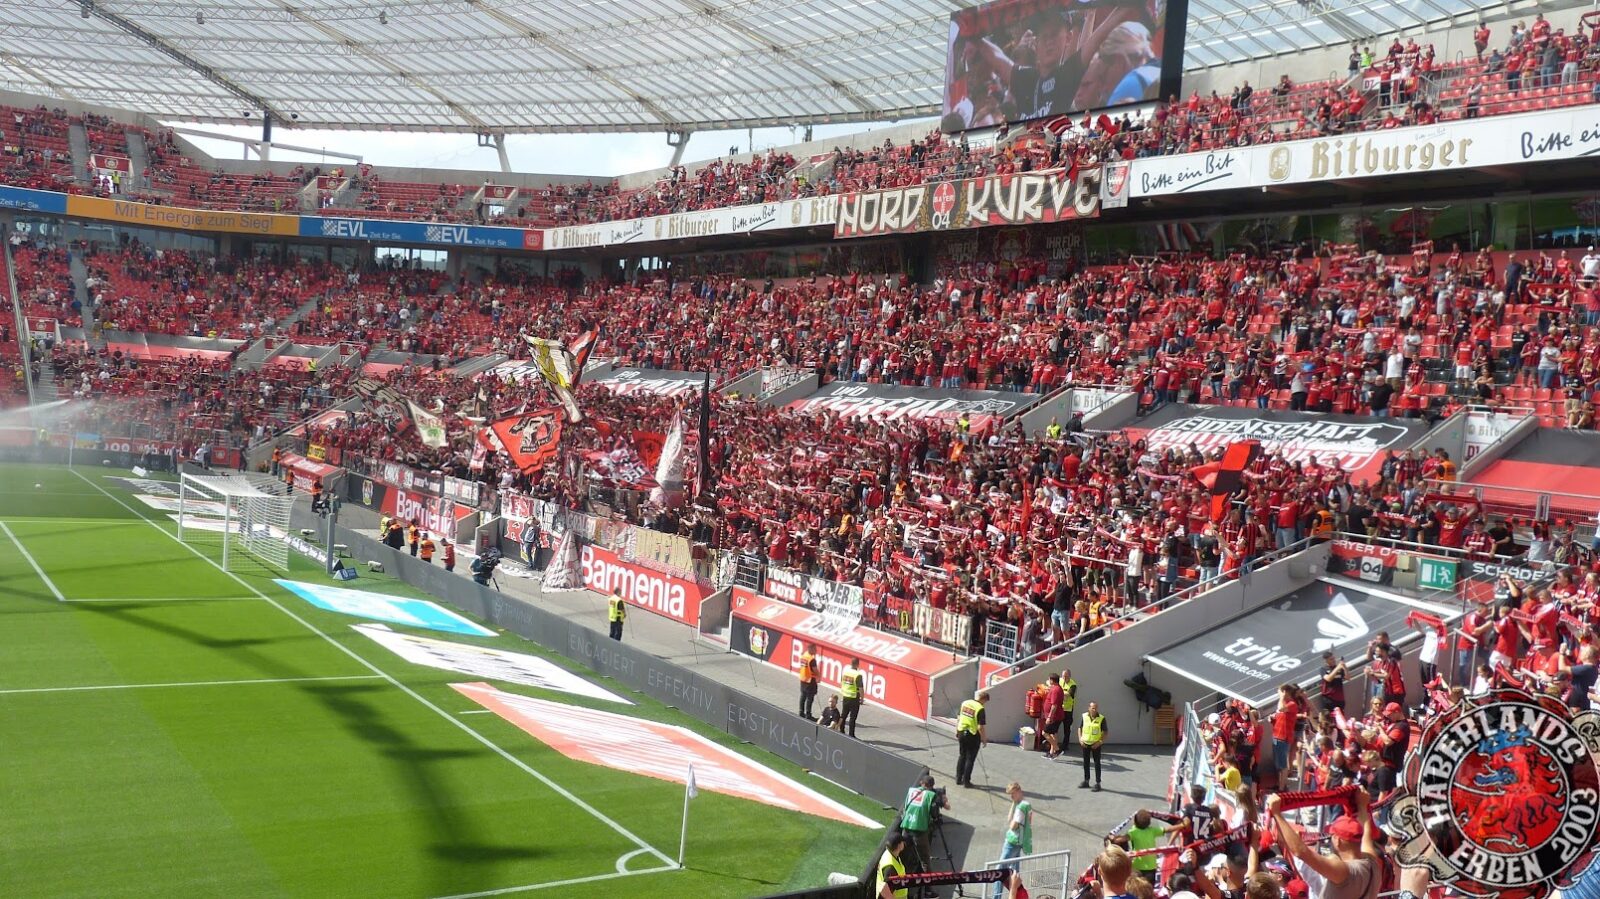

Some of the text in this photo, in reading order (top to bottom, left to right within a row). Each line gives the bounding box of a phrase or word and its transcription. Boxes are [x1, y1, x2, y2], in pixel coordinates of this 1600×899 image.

[1521, 122, 1600, 158] Bitte ei
[1309, 136, 1473, 179] Bitburger
[1142, 172, 1173, 193] Bitte
[1177, 167, 1202, 181] ein
[1205, 153, 1235, 174] Bit
[837, 186, 926, 234] NORD
[967, 168, 1102, 222] KURVE
[115, 202, 273, 232] Mit Energie zum Sieg!
[633, 221, 644, 234] Bit
[668, 217, 719, 237] Bitburger
[733, 205, 777, 231] Bitte ein Bit
[932, 212, 950, 229] 04
[337, 221, 368, 238] EVL
[441, 227, 473, 244] EVL
[563, 230, 601, 247] Bitburger
[1046, 236, 1061, 249] IHR
[1052, 247, 1071, 260] UNS
[1166, 418, 1384, 440] LEIDENSCHAFT
[767, 566, 802, 588] YOUNG
[1361, 562, 1382, 576] 04
[582, 545, 686, 618] Barmenia
[1202, 650, 1272, 681] www.trive.com
[1224, 636, 1302, 672] trive
[791, 638, 886, 701] Brmnia
[1192, 816, 1211, 840] 14
